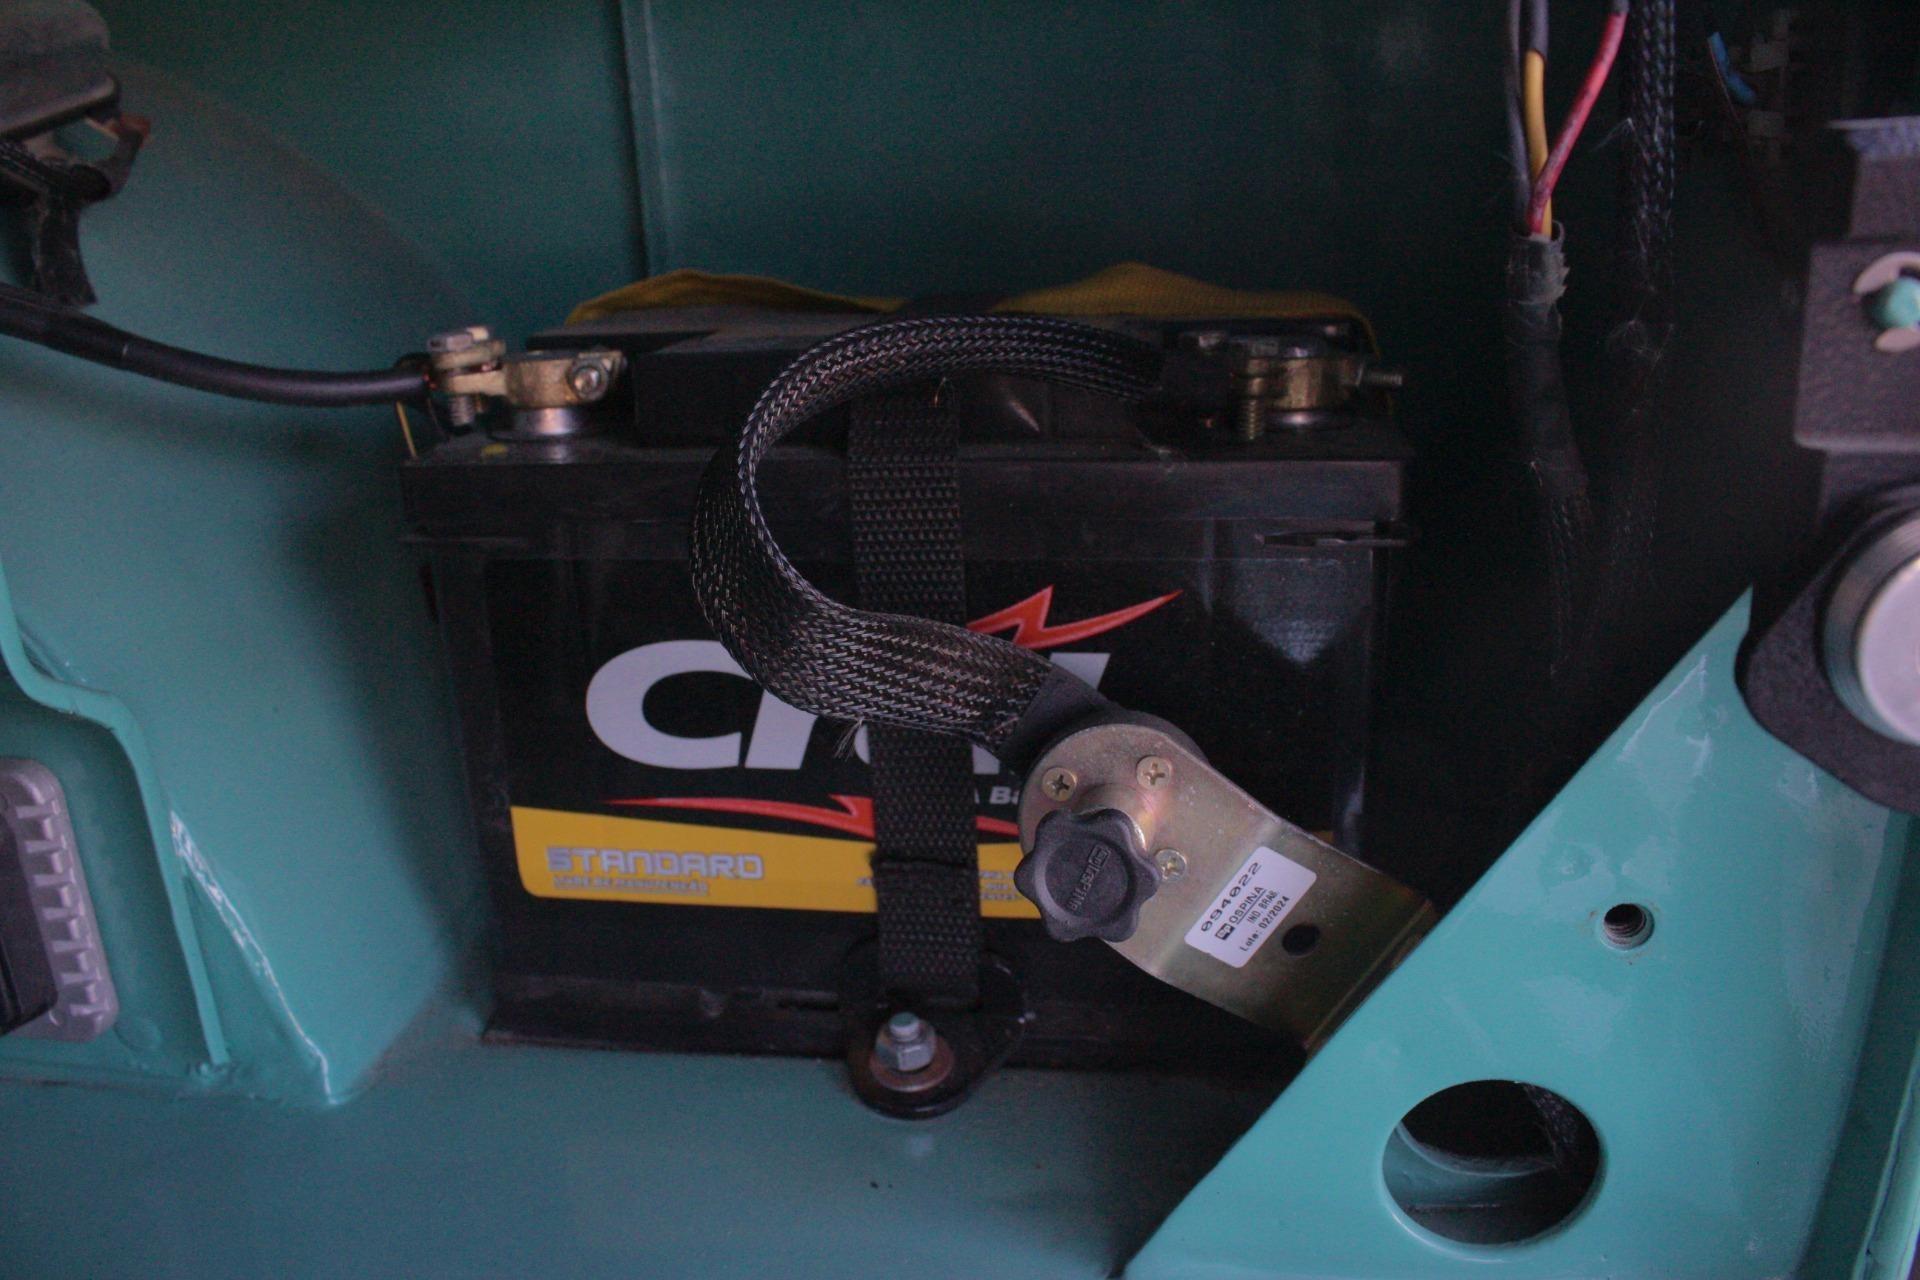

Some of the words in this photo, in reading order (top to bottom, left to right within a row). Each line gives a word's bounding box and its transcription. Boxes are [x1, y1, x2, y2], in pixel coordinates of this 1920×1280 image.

[546, 847, 764, 880] STANDARD
[1200, 862, 1261, 932] 094022
[1229, 886, 1264, 924] OSPINA
[1258, 895, 1290, 929] 02/2024
